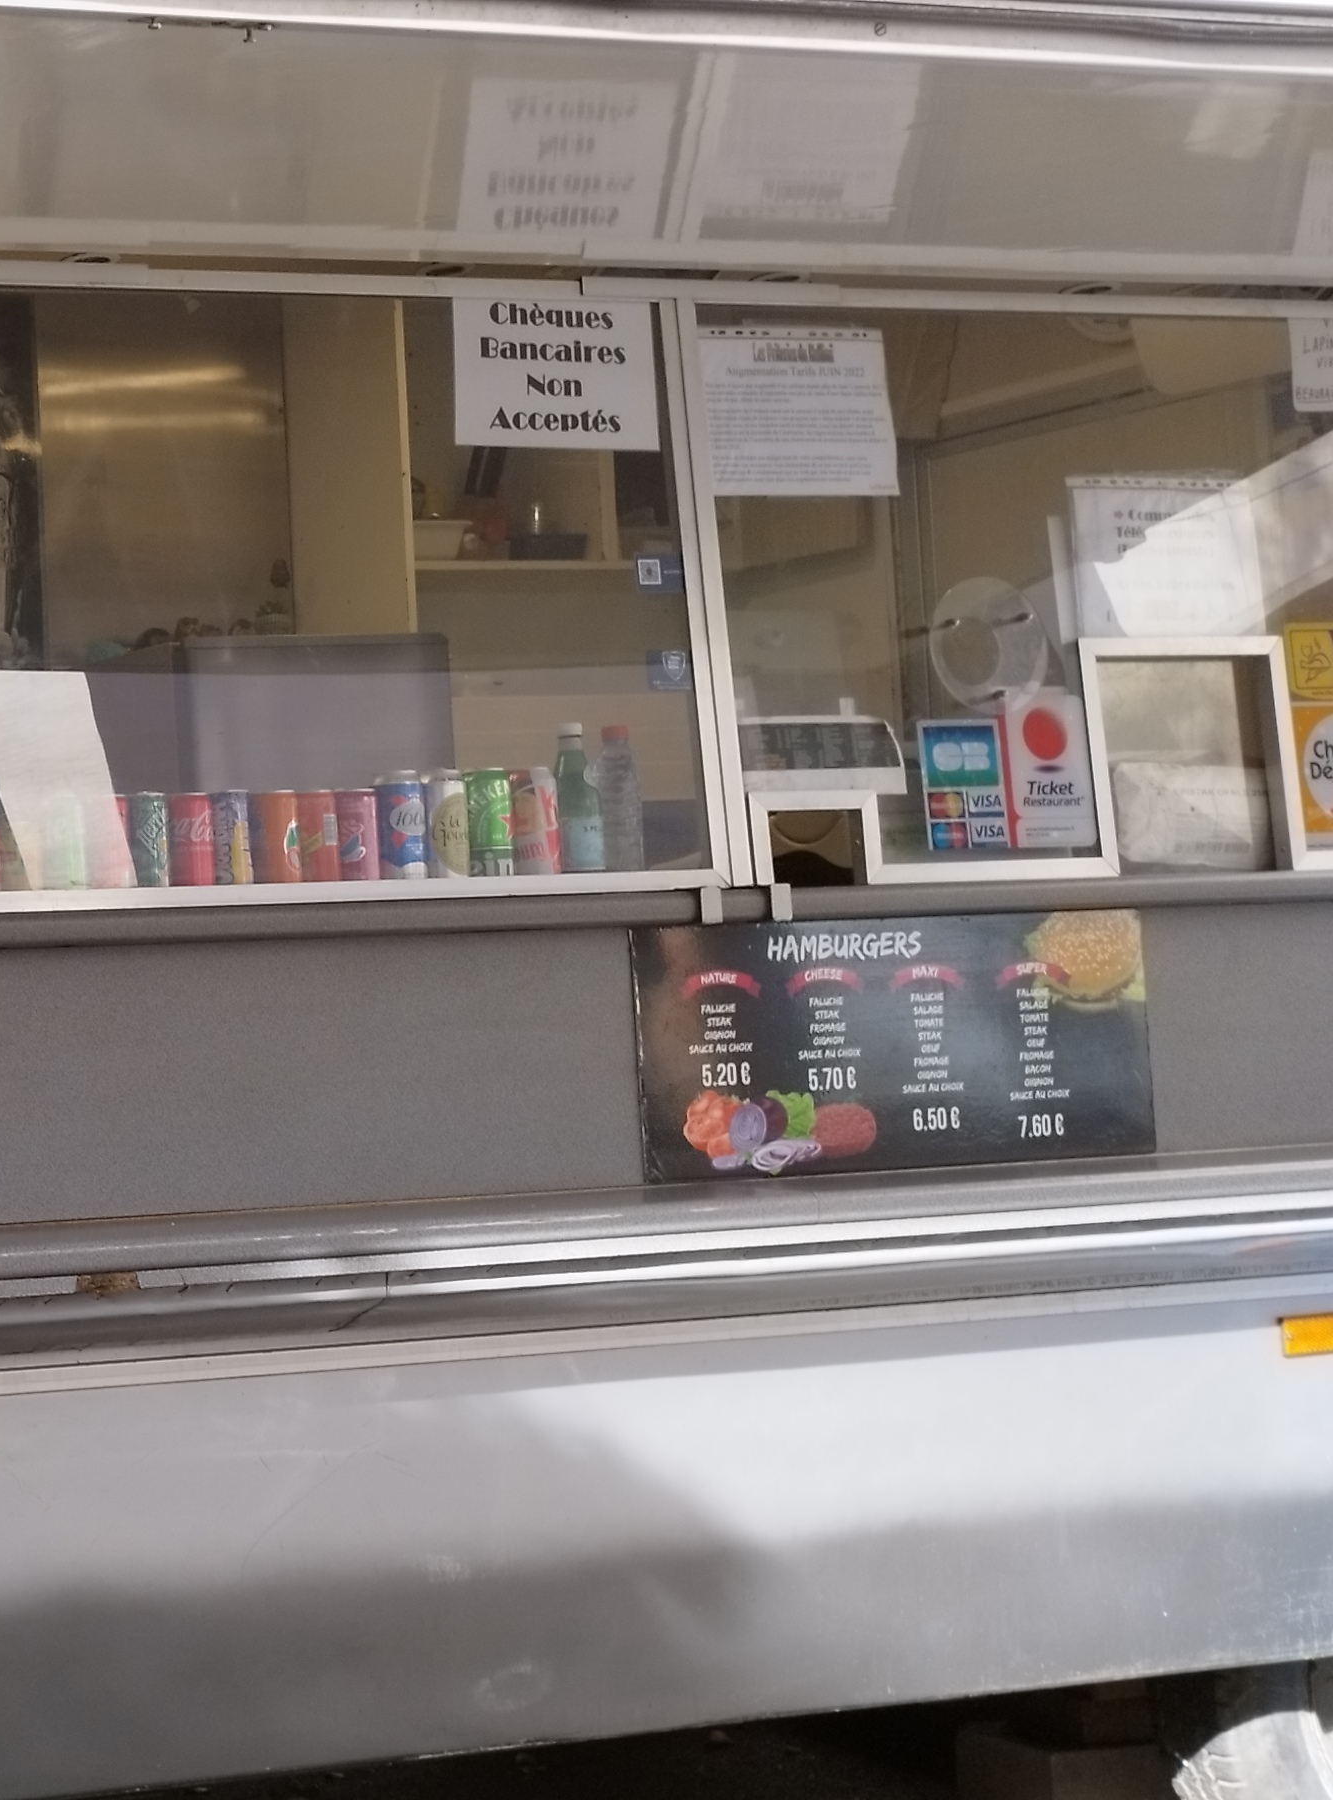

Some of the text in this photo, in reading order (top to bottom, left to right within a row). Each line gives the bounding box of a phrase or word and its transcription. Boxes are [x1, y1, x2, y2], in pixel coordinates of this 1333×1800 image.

[489, 302, 613, 329] Chèques
[480, 337, 626, 364] Bancaires
[725, 367, 865, 377] Augmentation Tarifs JUIN 2022
[526, 374, 582, 397] Non
[490, 407, 621, 432] Acceptés
[1027, 780, 1074, 796] Ticket
[971, 794, 1002, 807] VISA
[1023, 796, 1082, 808] Restaurant
[975, 826, 1005, 838] VISA
[768, 932, 921, 961] HAMBURGERS
[804, 968, 843, 981] CHEESE
[912, 966, 938, 979] MAXI
[1016, 962, 1046, 976] SUPER
[700, 973, 737, 986] NATURE
[701, 1003, 736, 1014] FALUCHE
[706, 1017, 731, 1027] STEAK
[704, 1030, 736, 1040] OIGNON
[689, 1043, 753, 1054] SAUCE AU CHOIX
[702, 1063, 750, 1087] 5.20 €
[808, 1067, 856, 1091] 5.70 €
[913, 1107, 960, 1131] 6.50 €
[1018, 1114, 1064, 1139] 7.60 €
